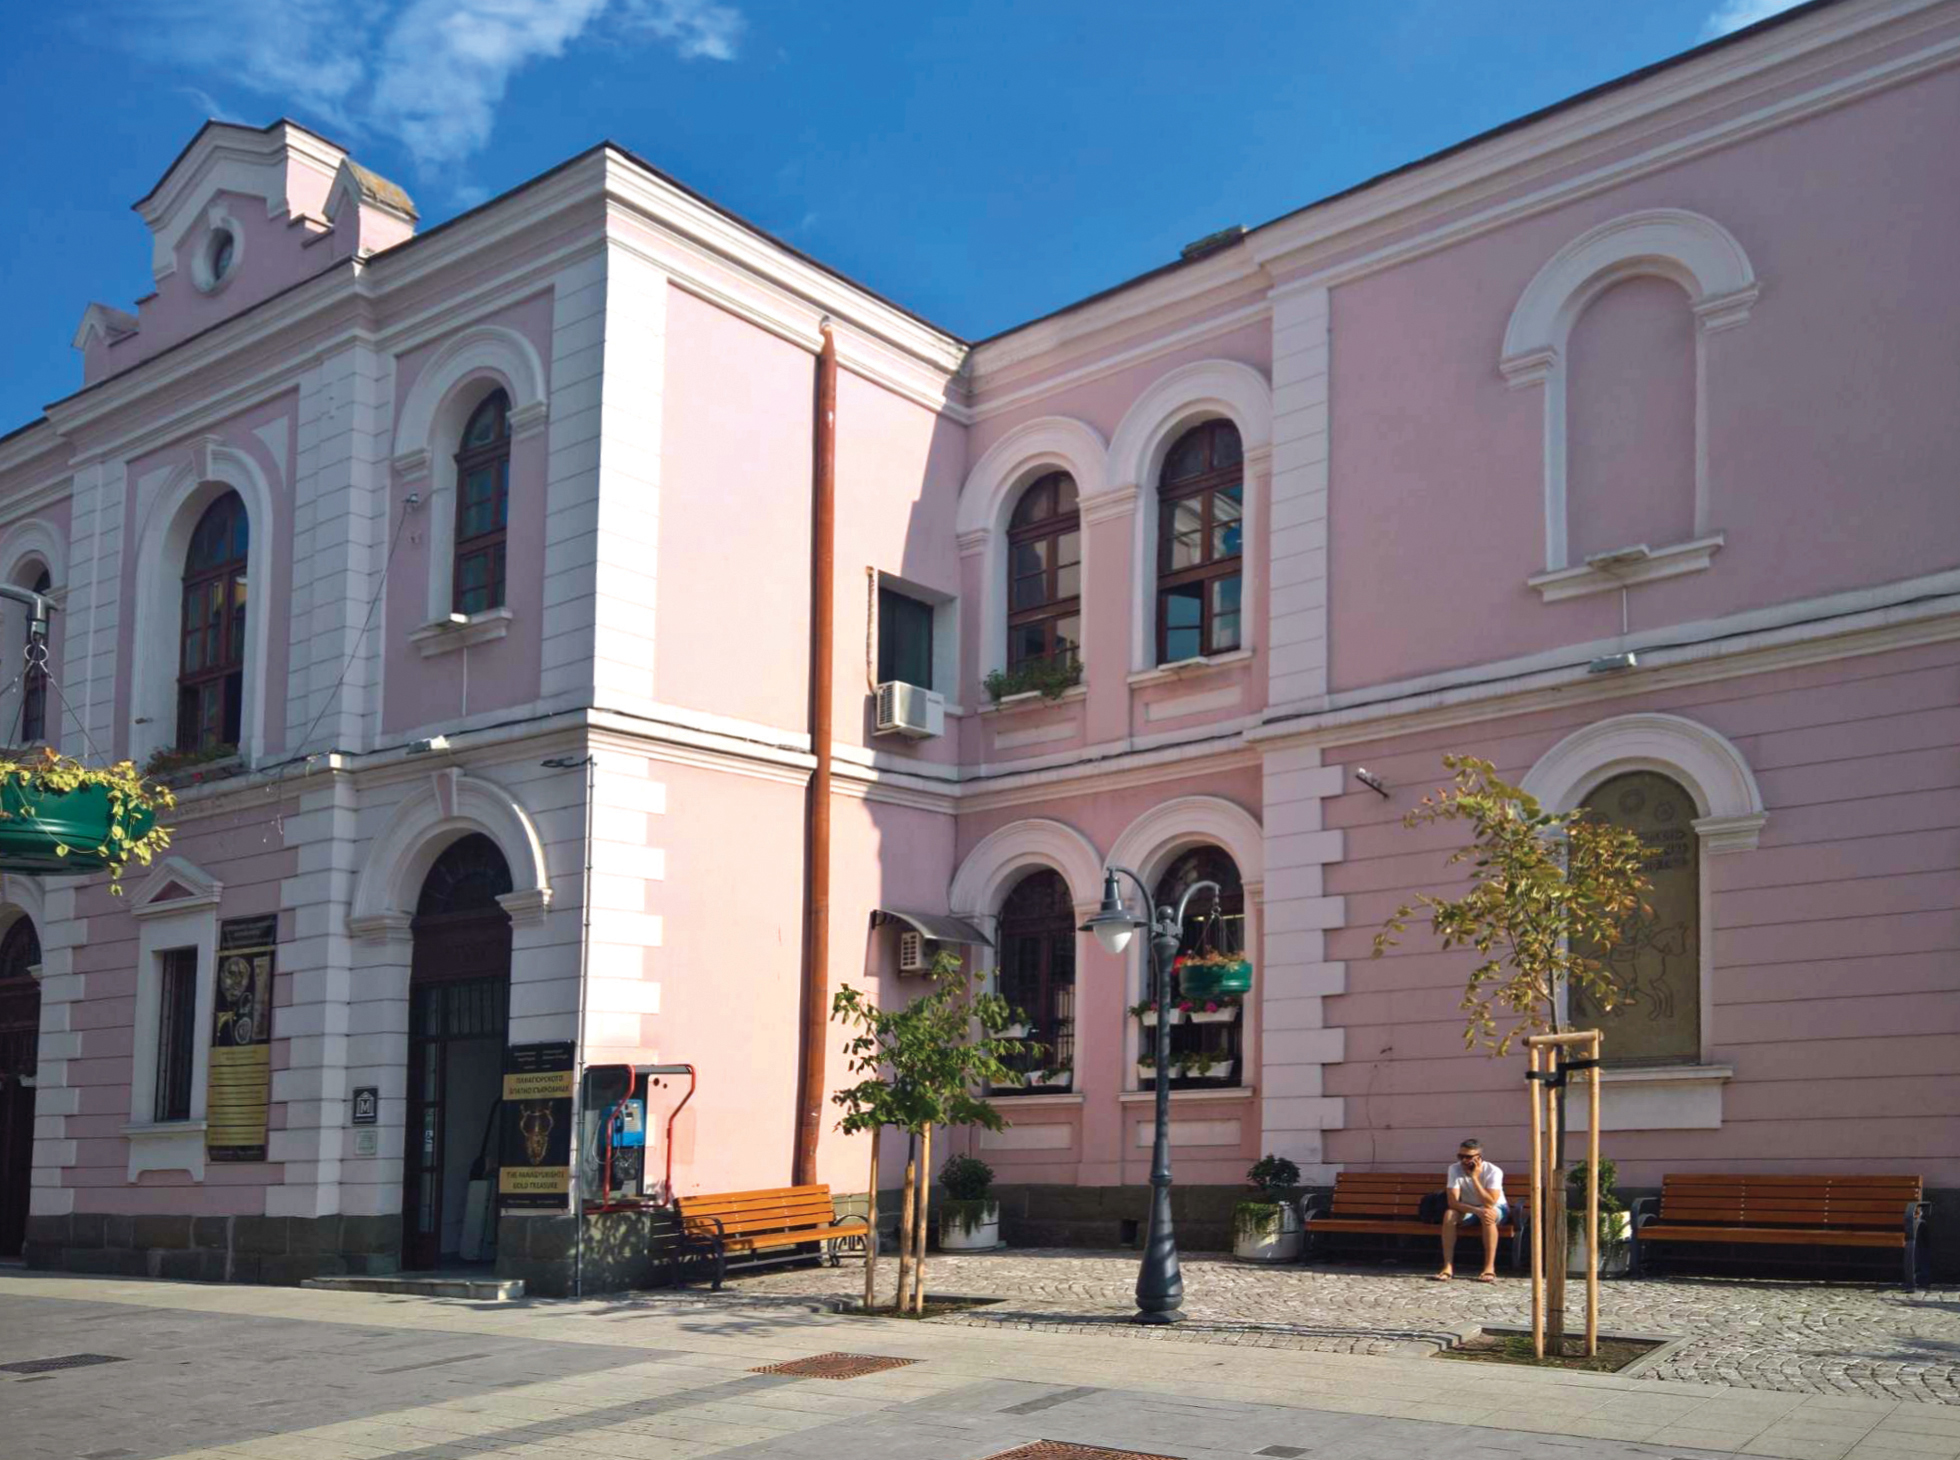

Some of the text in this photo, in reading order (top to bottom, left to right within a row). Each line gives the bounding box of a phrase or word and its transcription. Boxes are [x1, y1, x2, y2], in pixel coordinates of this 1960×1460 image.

[516, 1075, 563, 1084] ПАНАГЮРСКОТО
[507, 1171, 517, 1179] THE
[530, 1181, 558, 1189] TREASURE
